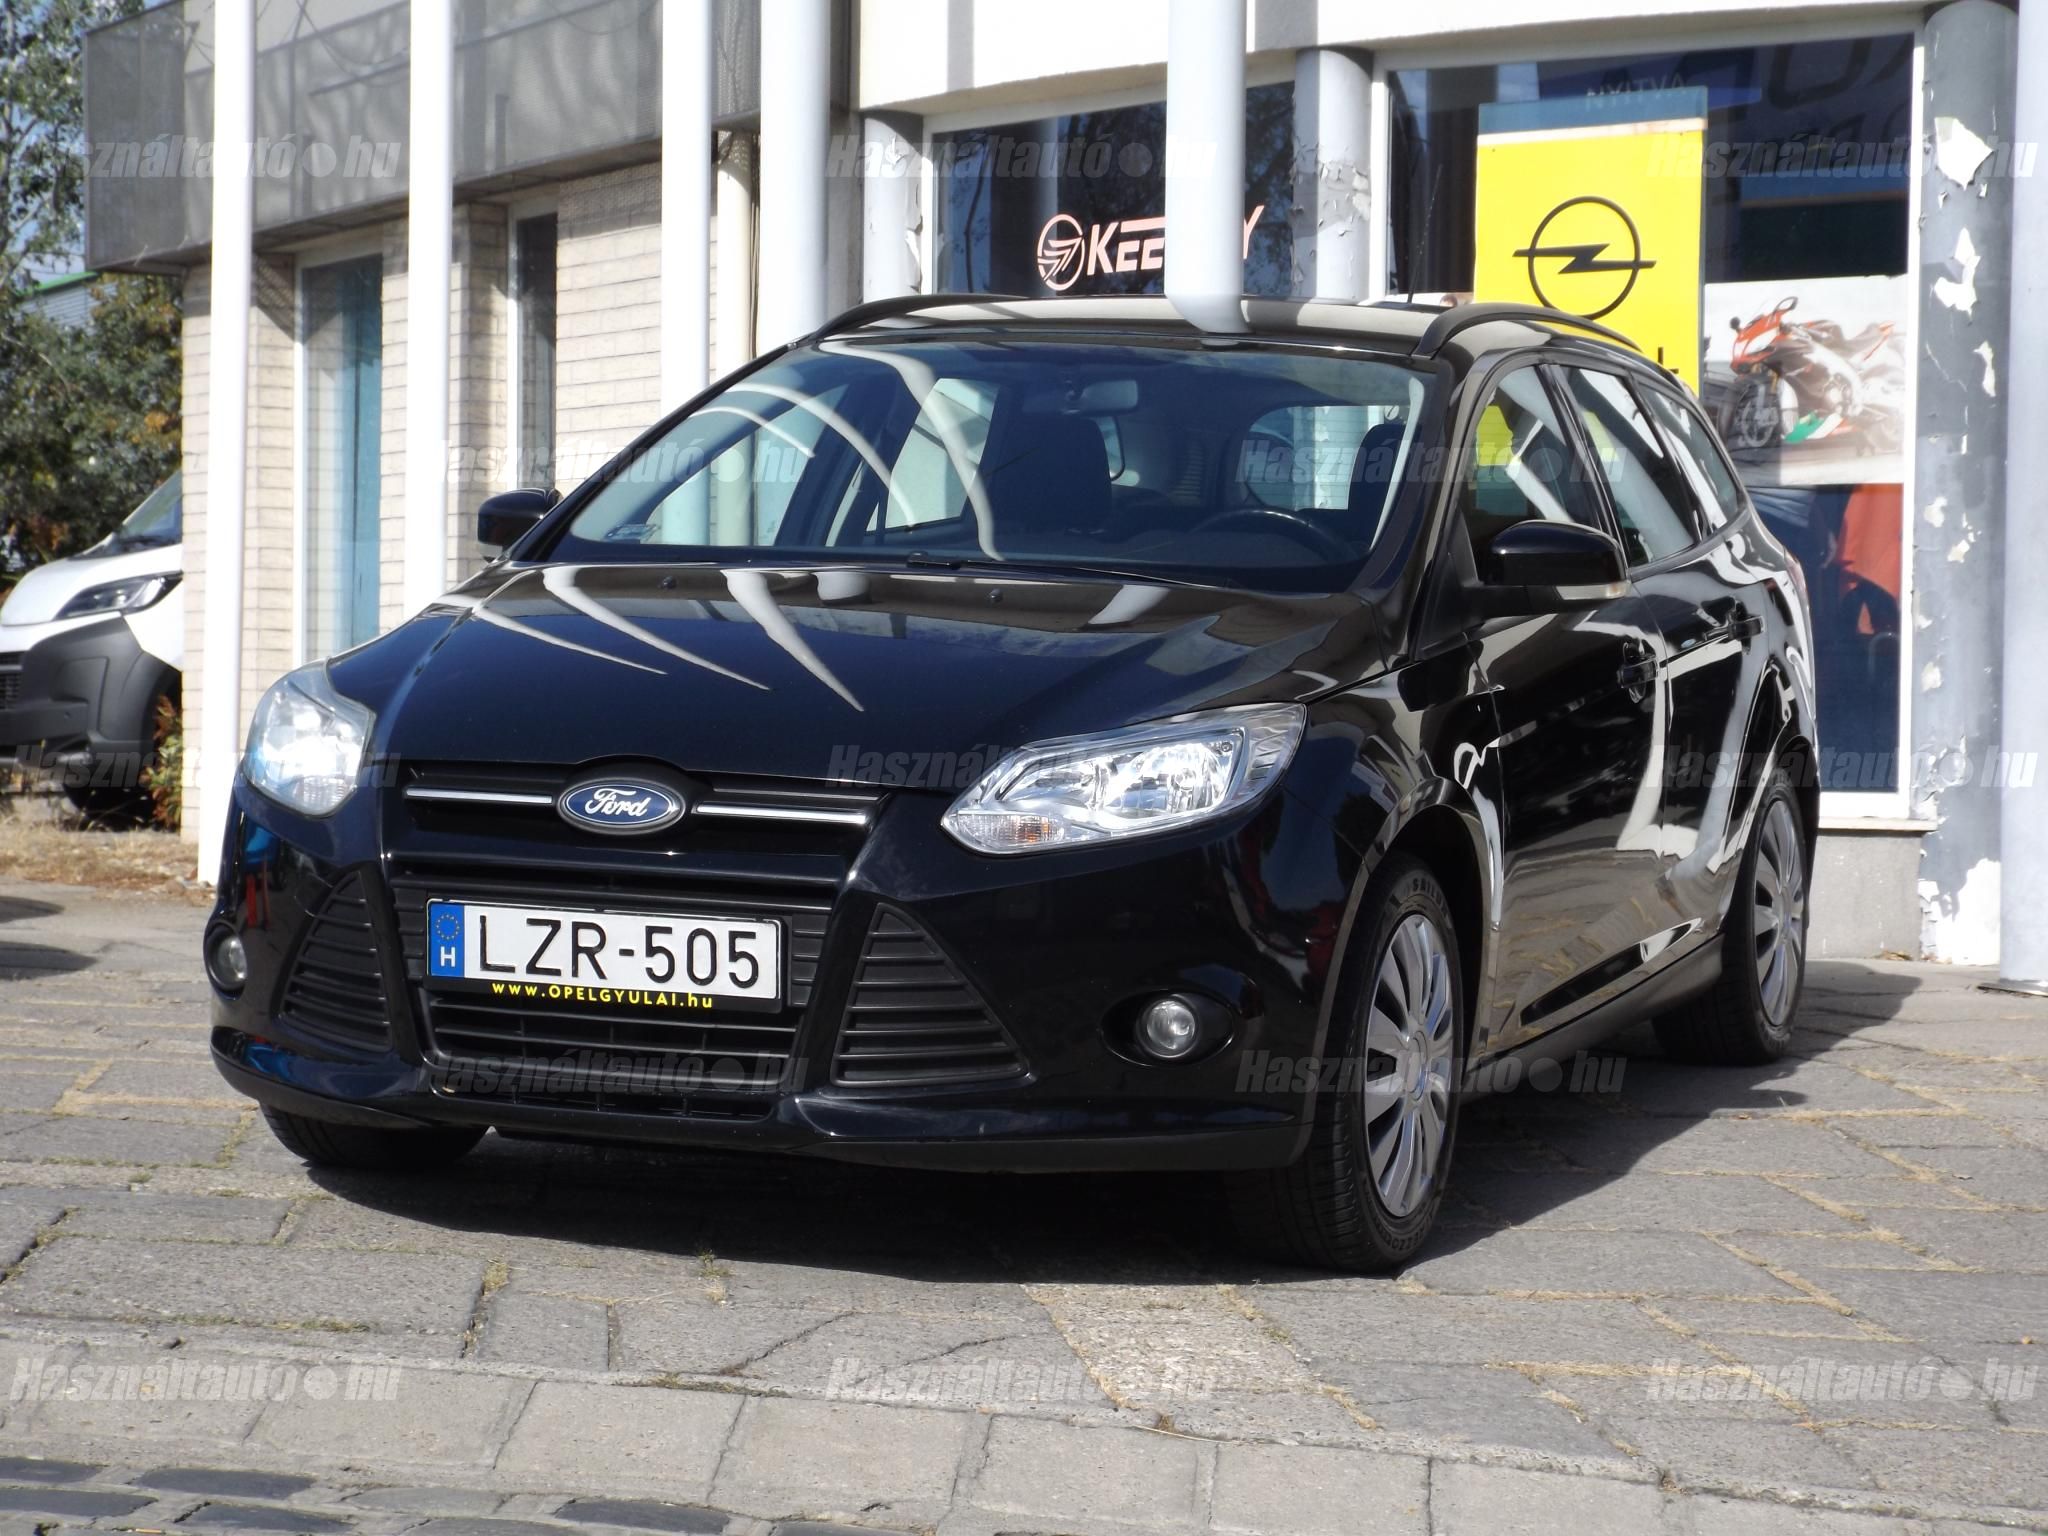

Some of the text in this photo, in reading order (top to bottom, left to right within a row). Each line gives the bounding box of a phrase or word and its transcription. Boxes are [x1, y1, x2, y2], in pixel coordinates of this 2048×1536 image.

[585, 788, 650, 817] Ford
[440, 946, 456, 968] H
[480, 914, 760, 989] LZR-505
[492, 982, 713, 1009] www.OPELGYULAI.hu
